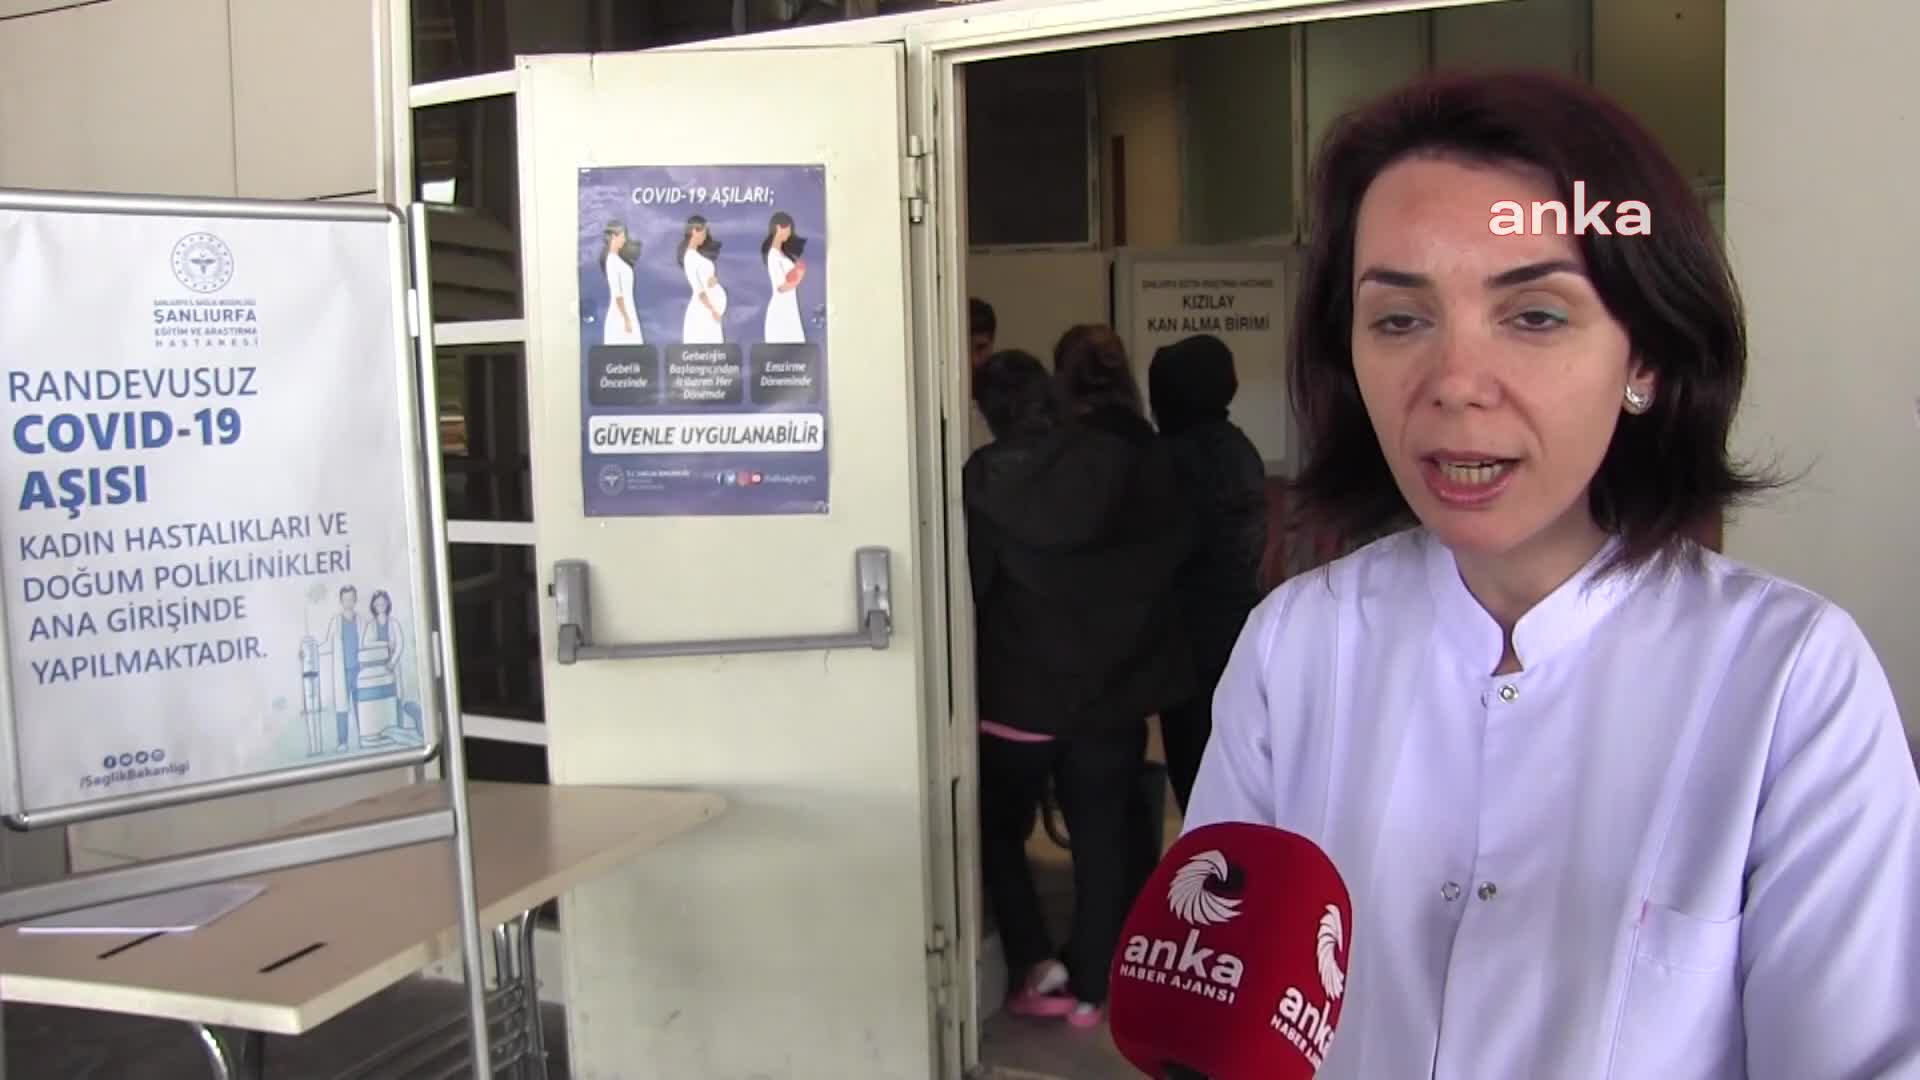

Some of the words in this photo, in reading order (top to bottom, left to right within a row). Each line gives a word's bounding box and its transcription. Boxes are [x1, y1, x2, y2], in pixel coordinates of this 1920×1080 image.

[631, 186, 706, 205] COVID-19
[710, 186, 775, 207] AŞILARI;
[153, 308, 257, 324] ŞANLIURFA
[1182, 295, 1235, 309] KIZILAY
[1147, 318, 1177, 332] KAN
[1182, 317, 1221, 332] ALMA
[1225, 314, 1270, 331] BİRİMİ
[9, 367, 258, 402] RANDEVUSUZ
[606, 363, 641, 374] Gebelik
[765, 360, 807, 373] Emzirme
[13, 407, 241, 454] COVID-19
[593, 424, 675, 446] GÜVENLE
[681, 420, 818, 445] UYGULANABİLİR
[18, 465, 147, 519] AŞISI
[20, 530, 115, 561] KADIN
[125, 515, 311, 552] HASTALIKLARI
[318, 512, 349, 536] VE
[23, 567, 144, 603] DOĞUM
[155, 545, 352, 590] POLİKLİNİKLERİ
[29, 613, 97, 642] ANA
[106, 596, 248, 634] GİRİŞİNDE
[31, 636, 268, 685] YAPILMAKTADIR.
[1123, 928, 1245, 988] anka
[1120, 964, 1166, 985] HABER
[1170, 975, 1235, 1004] AJANSI
